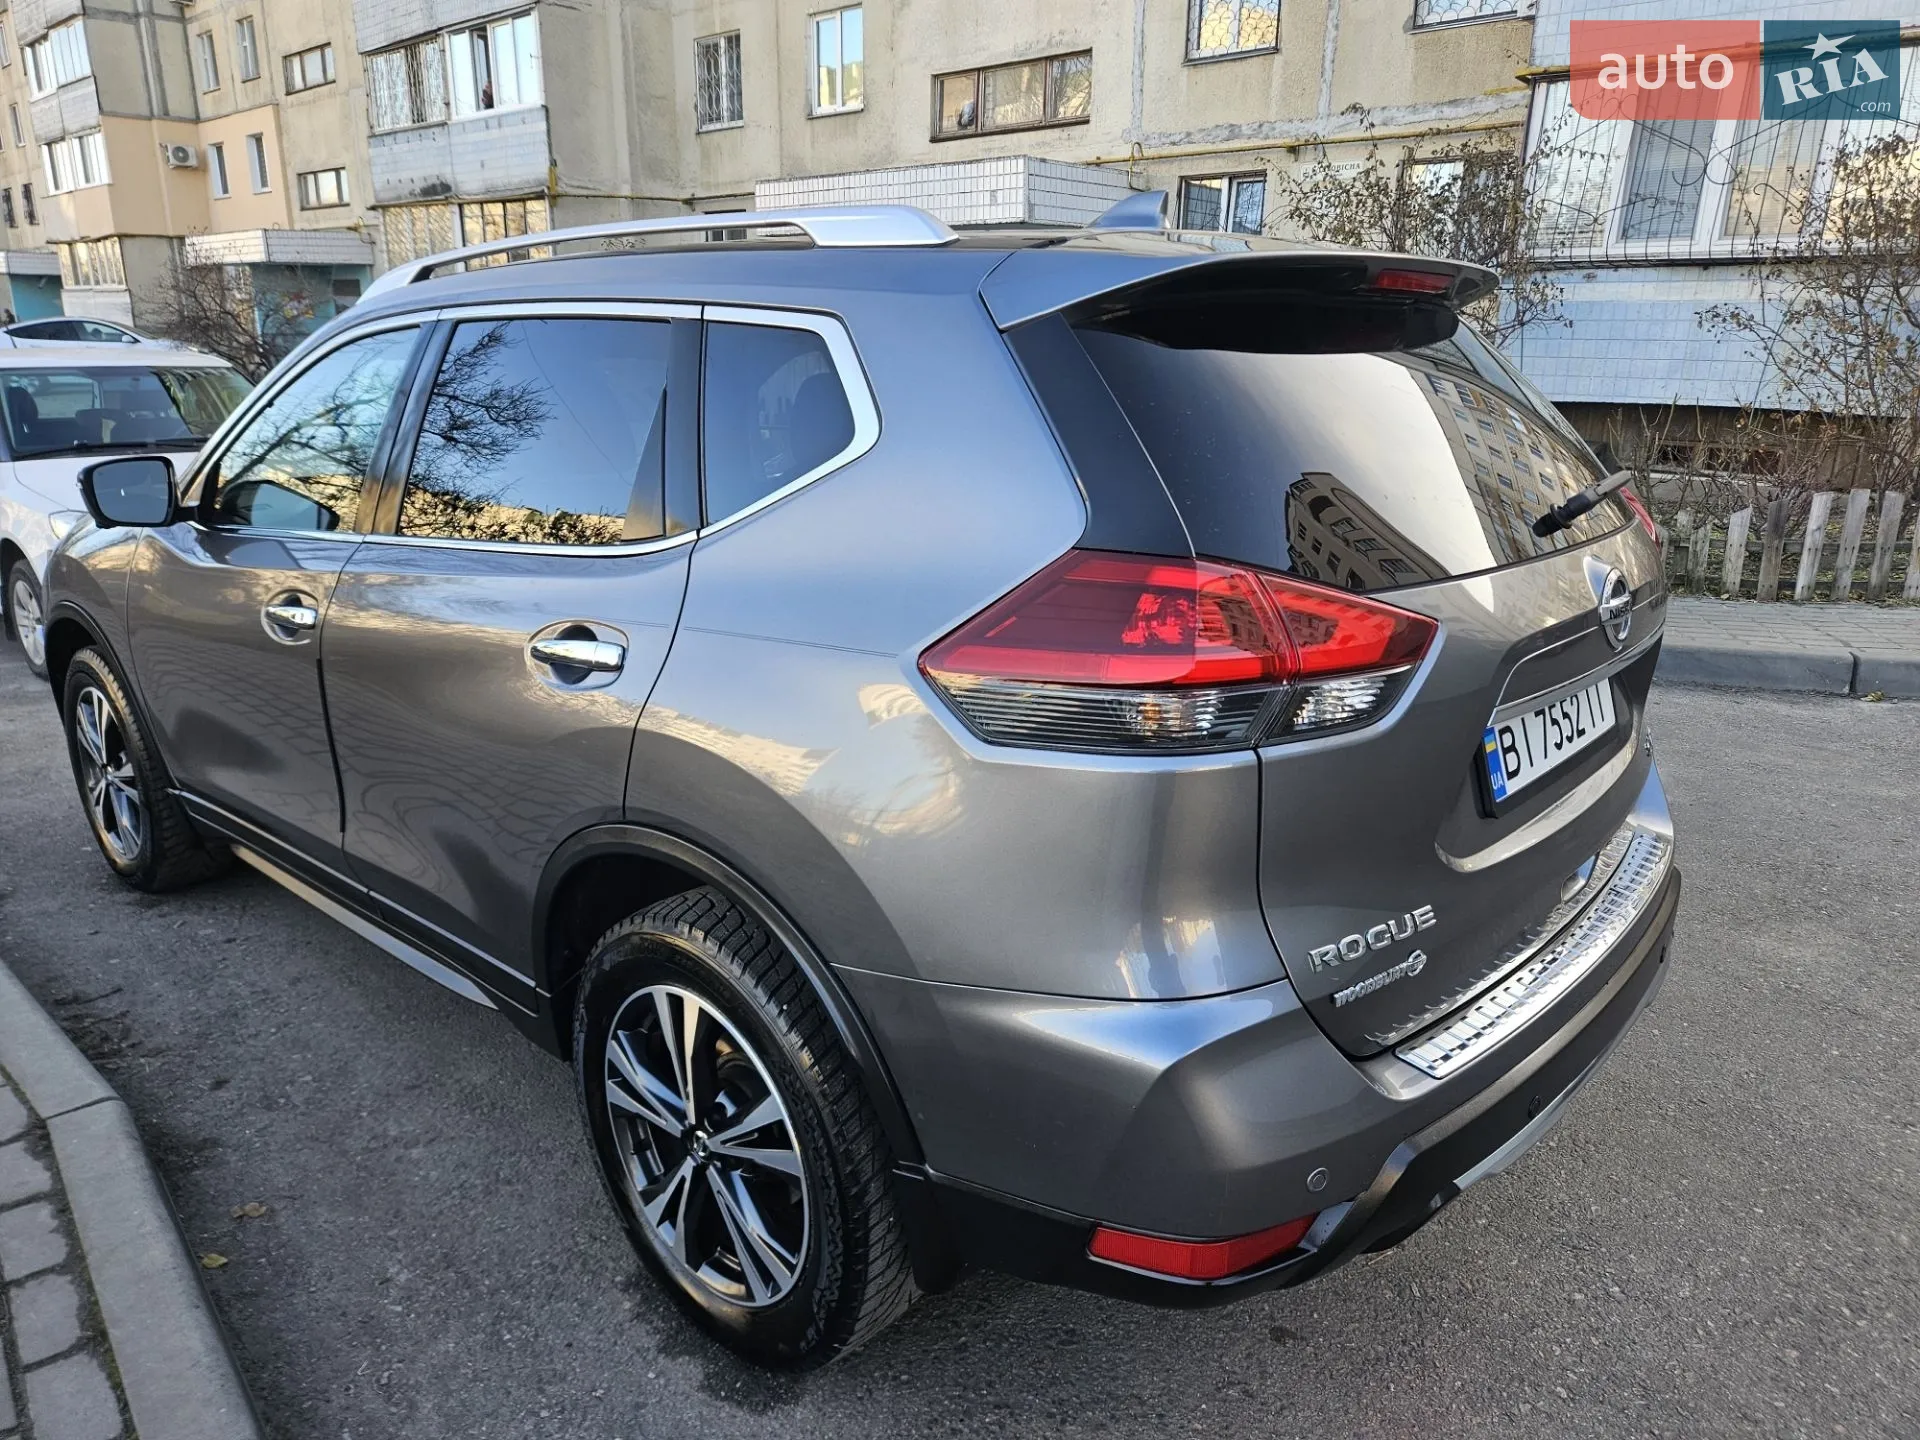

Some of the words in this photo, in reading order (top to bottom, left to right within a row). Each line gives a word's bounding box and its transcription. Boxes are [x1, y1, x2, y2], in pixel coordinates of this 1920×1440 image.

[1534, 694, 1586, 760] 7552
[1491, 774, 1504, 790] UA
[1308, 904, 1437, 974] ROGUE
